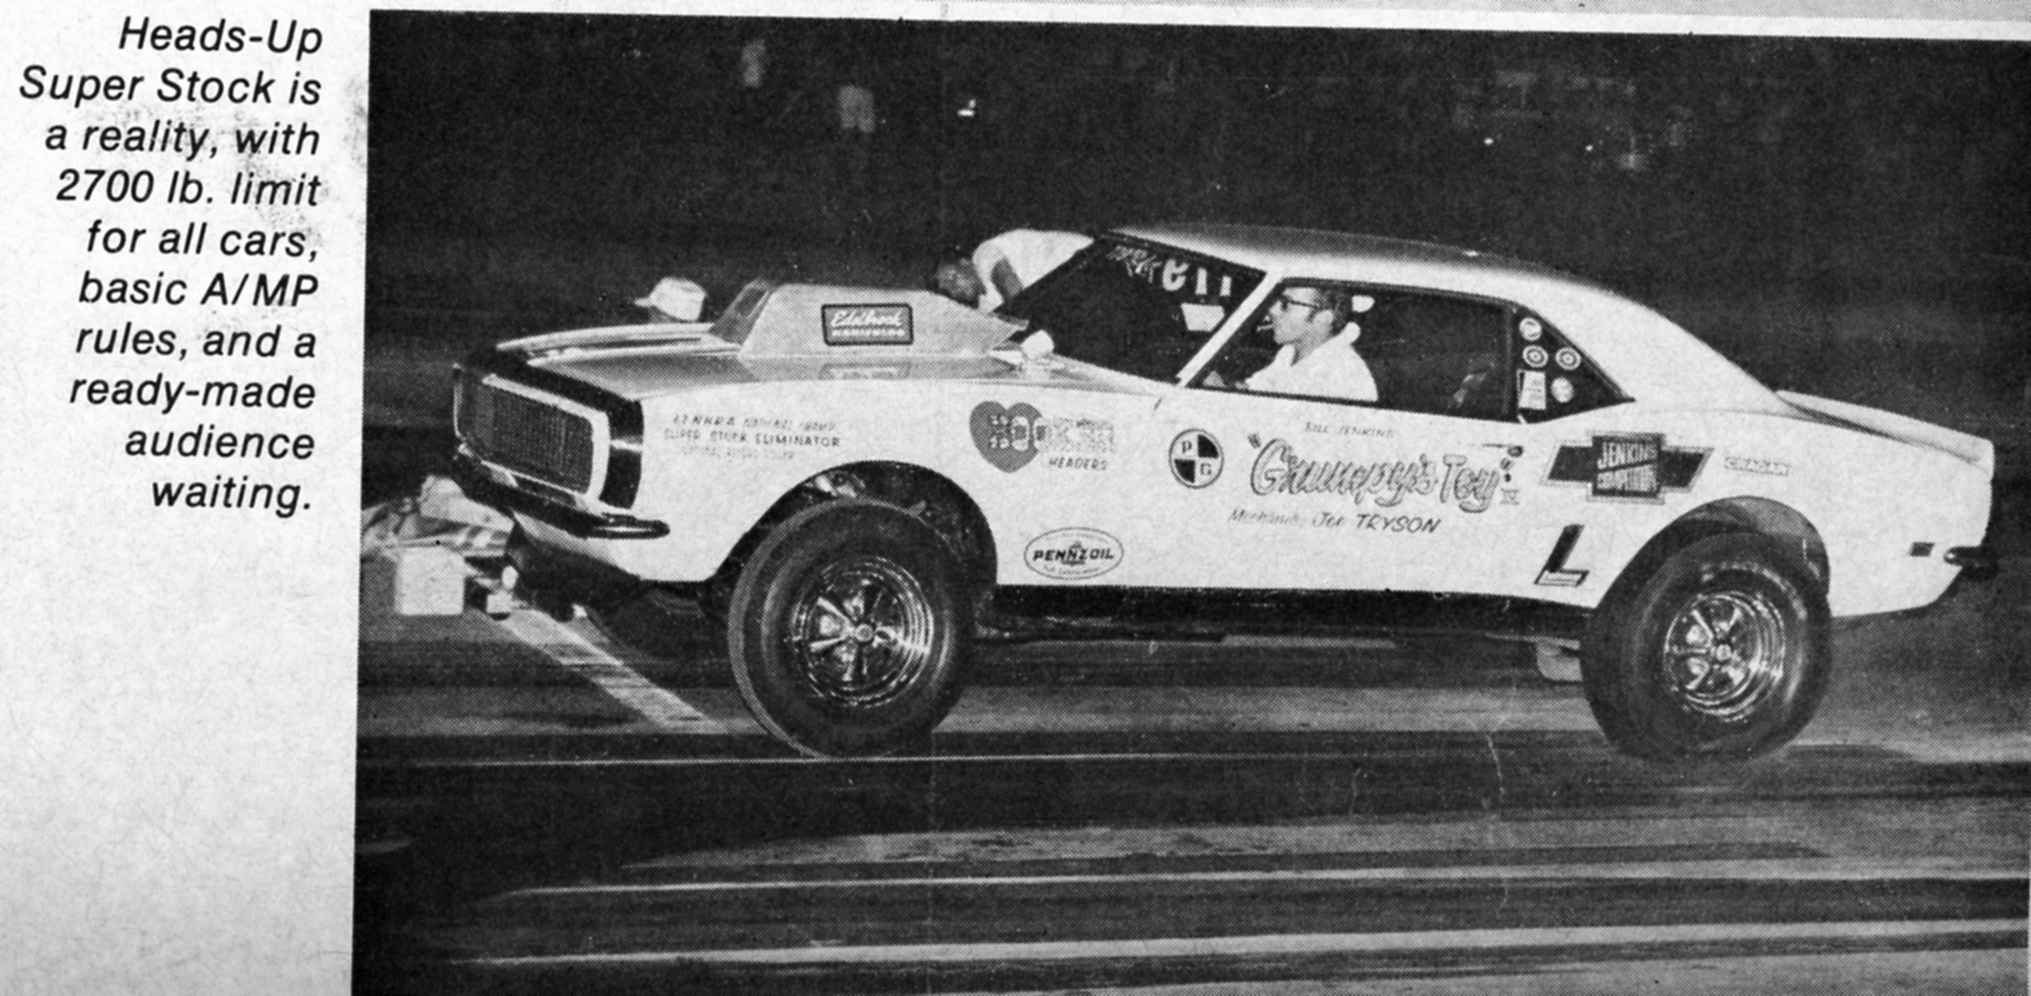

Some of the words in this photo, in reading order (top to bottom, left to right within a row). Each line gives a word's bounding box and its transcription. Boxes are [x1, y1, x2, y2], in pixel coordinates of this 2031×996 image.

[119, 16, 323, 62] Heads-Up
[19, 64, 144, 109] Super
[157, 67, 275, 104] Stock
[288, 71, 322, 106] is
[45, 125, 67, 150] a
[82, 119, 218, 162] reality,
[235, 121, 320, 155] with
[56, 168, 154, 203] 2700
[167, 170, 213, 204] lb.
[231, 171, 322, 207] limit
[87, 219, 147, 254] for
[158, 222, 208, 255] all
[220, 230, 317, 262] cars,
[78, 270, 187, 305] basic
[200, 272, 319, 307] A/MP
[76, 321, 187, 360] rules,
[202, 324, 282, 358] and
[294, 333, 316, 358] a
[69, 372, 316, 415] ready-made
[125, 424, 315, 460] audience
[755, 432, 840, 448] ELIMINATOR
[1597, 441, 1657, 468] JENKINS
[1049, 457, 1109, 471] HEADERS
[152, 474, 310, 519] waiting.
[1355, 512, 1442, 534] TRYSON
[1032, 548, 1115, 562] PENNZOIL
